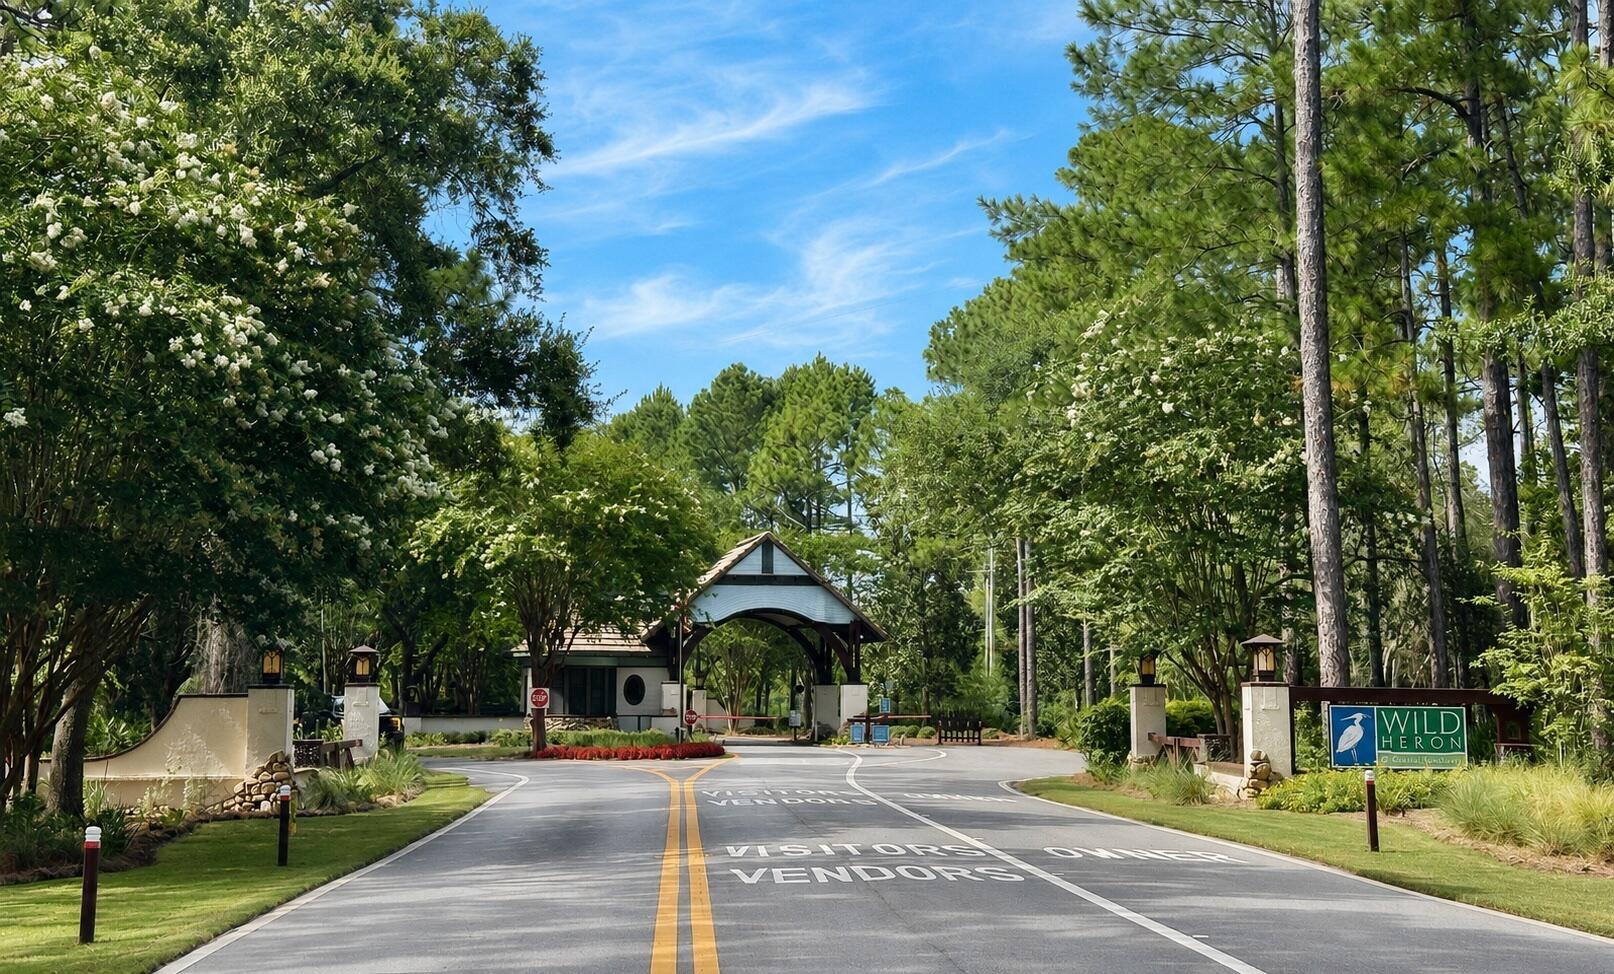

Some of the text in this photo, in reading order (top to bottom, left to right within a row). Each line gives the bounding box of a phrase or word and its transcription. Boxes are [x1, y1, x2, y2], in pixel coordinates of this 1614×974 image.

[1381, 710, 1461, 735] WILD
[1381, 736, 1462, 750] HERON
[707, 798, 878, 806] VENDORS
[724, 843, 987, 857] VISITORS
[1043, 847, 1249, 864] OWNER
[730, 865, 1025, 884] VENDORS
